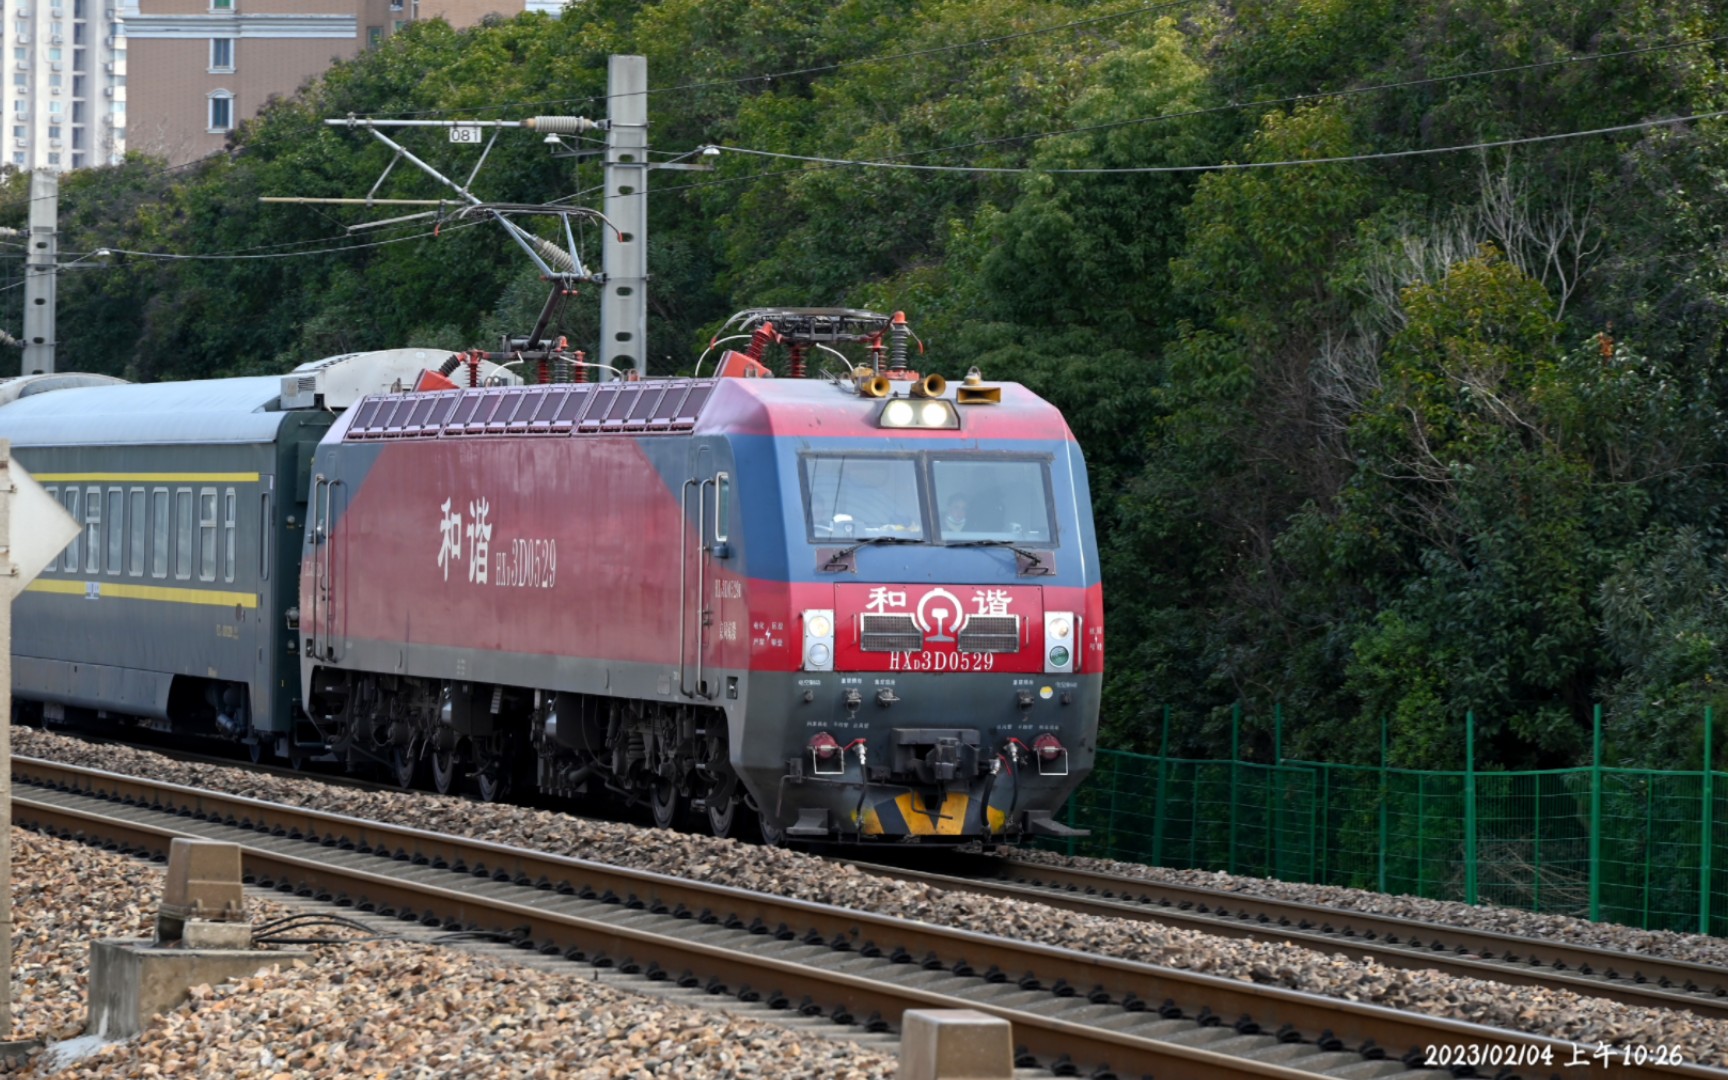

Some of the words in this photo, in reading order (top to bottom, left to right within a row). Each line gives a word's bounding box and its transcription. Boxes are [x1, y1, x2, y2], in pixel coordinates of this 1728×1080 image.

[451, 128, 478, 142] 081
[437, 496, 492, 585] 和谐
[865, 586, 907, 613] 和
[971, 589, 1013, 615] 谐
[889, 651, 994, 671] HXD3D0529
